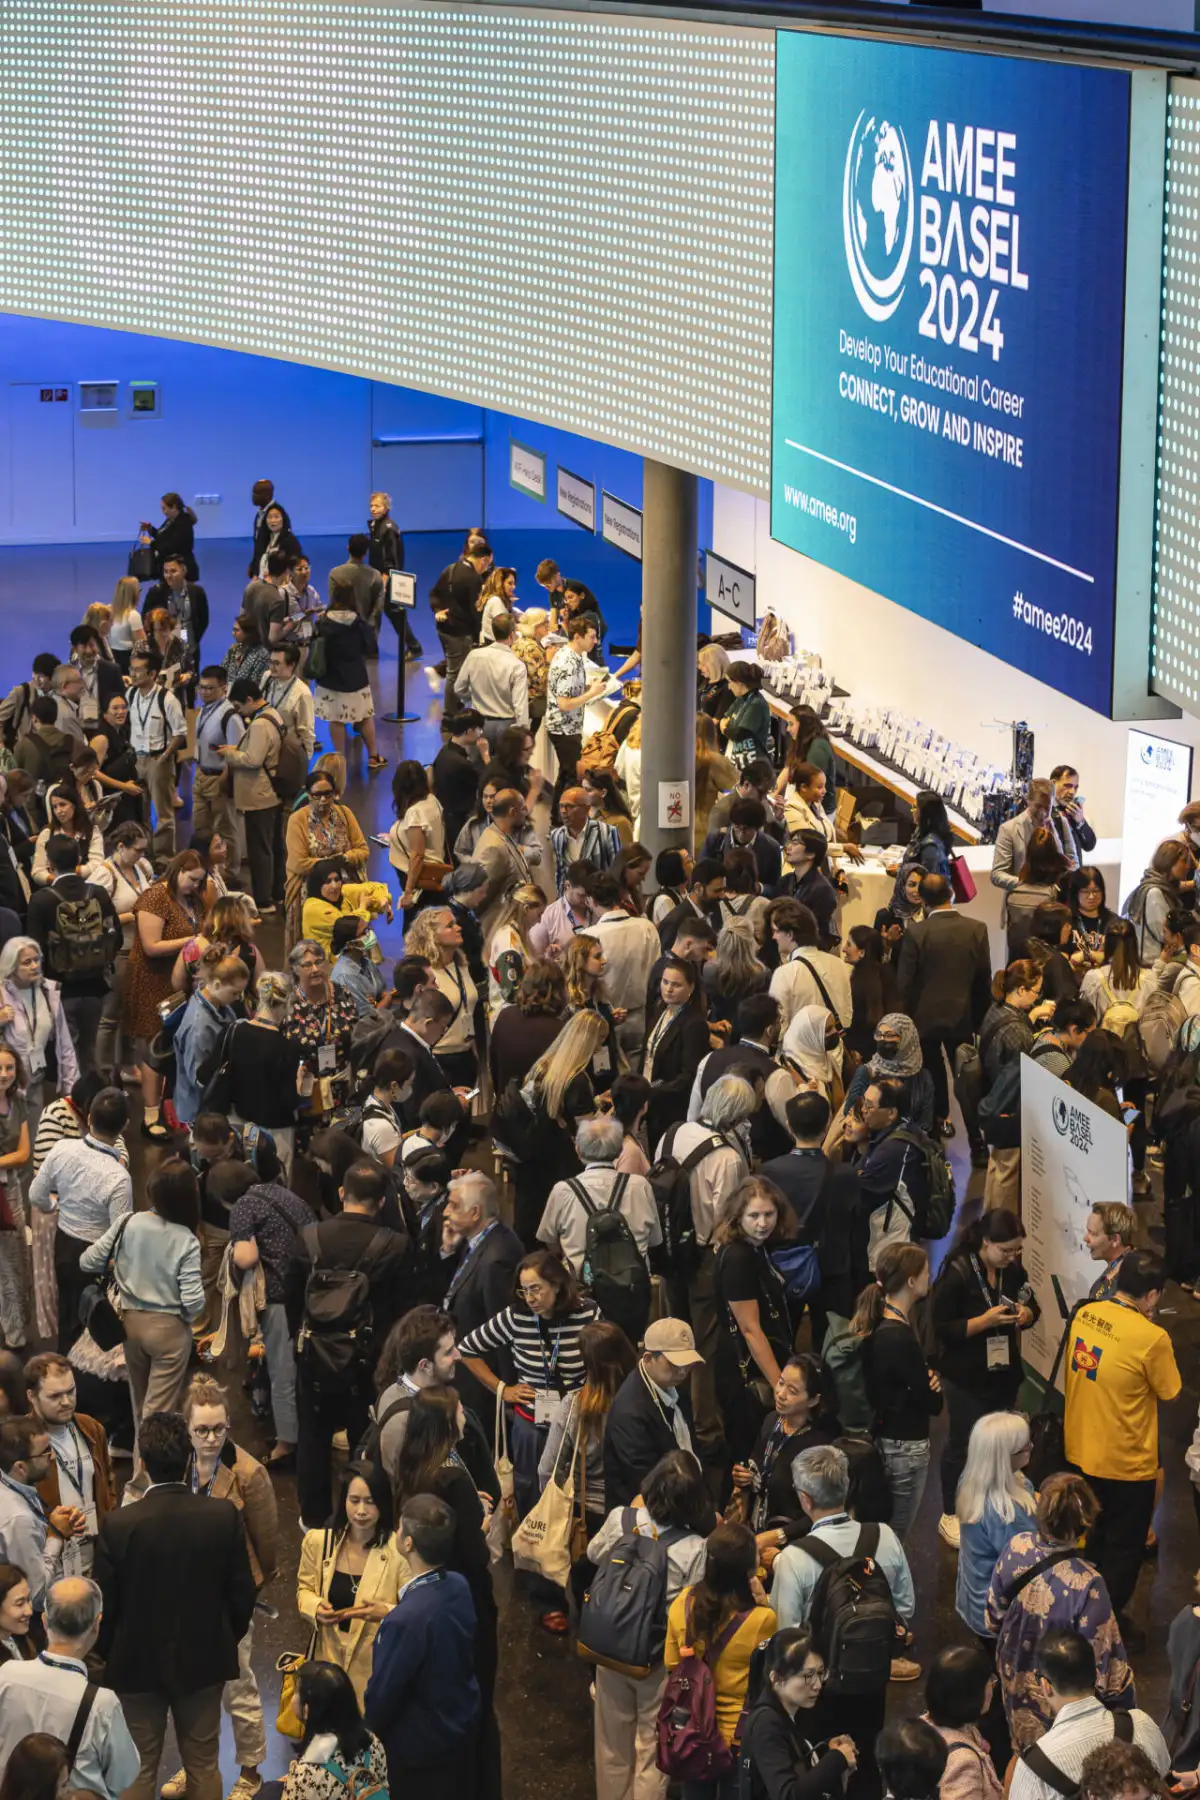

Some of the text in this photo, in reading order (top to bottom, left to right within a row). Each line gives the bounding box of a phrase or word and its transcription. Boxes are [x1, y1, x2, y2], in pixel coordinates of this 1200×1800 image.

[920, 119, 1017, 207] AMEE
[919, 194, 1029, 291] BASEL
[918, 267, 1004, 362] 2024
[839, 328, 1025, 419] Develop Your Educational Career
[839, 371, 1024, 468] CONNECT, GROW AND INSPIRE
[783, 483, 857, 544] www.amee.org
[718, 573, 741, 608] A-C
[1012, 590, 1093, 656] #amee2024
[1069, 1105, 1091, 1130] AMEE
[1069, 1130, 1089, 1155] 2024
